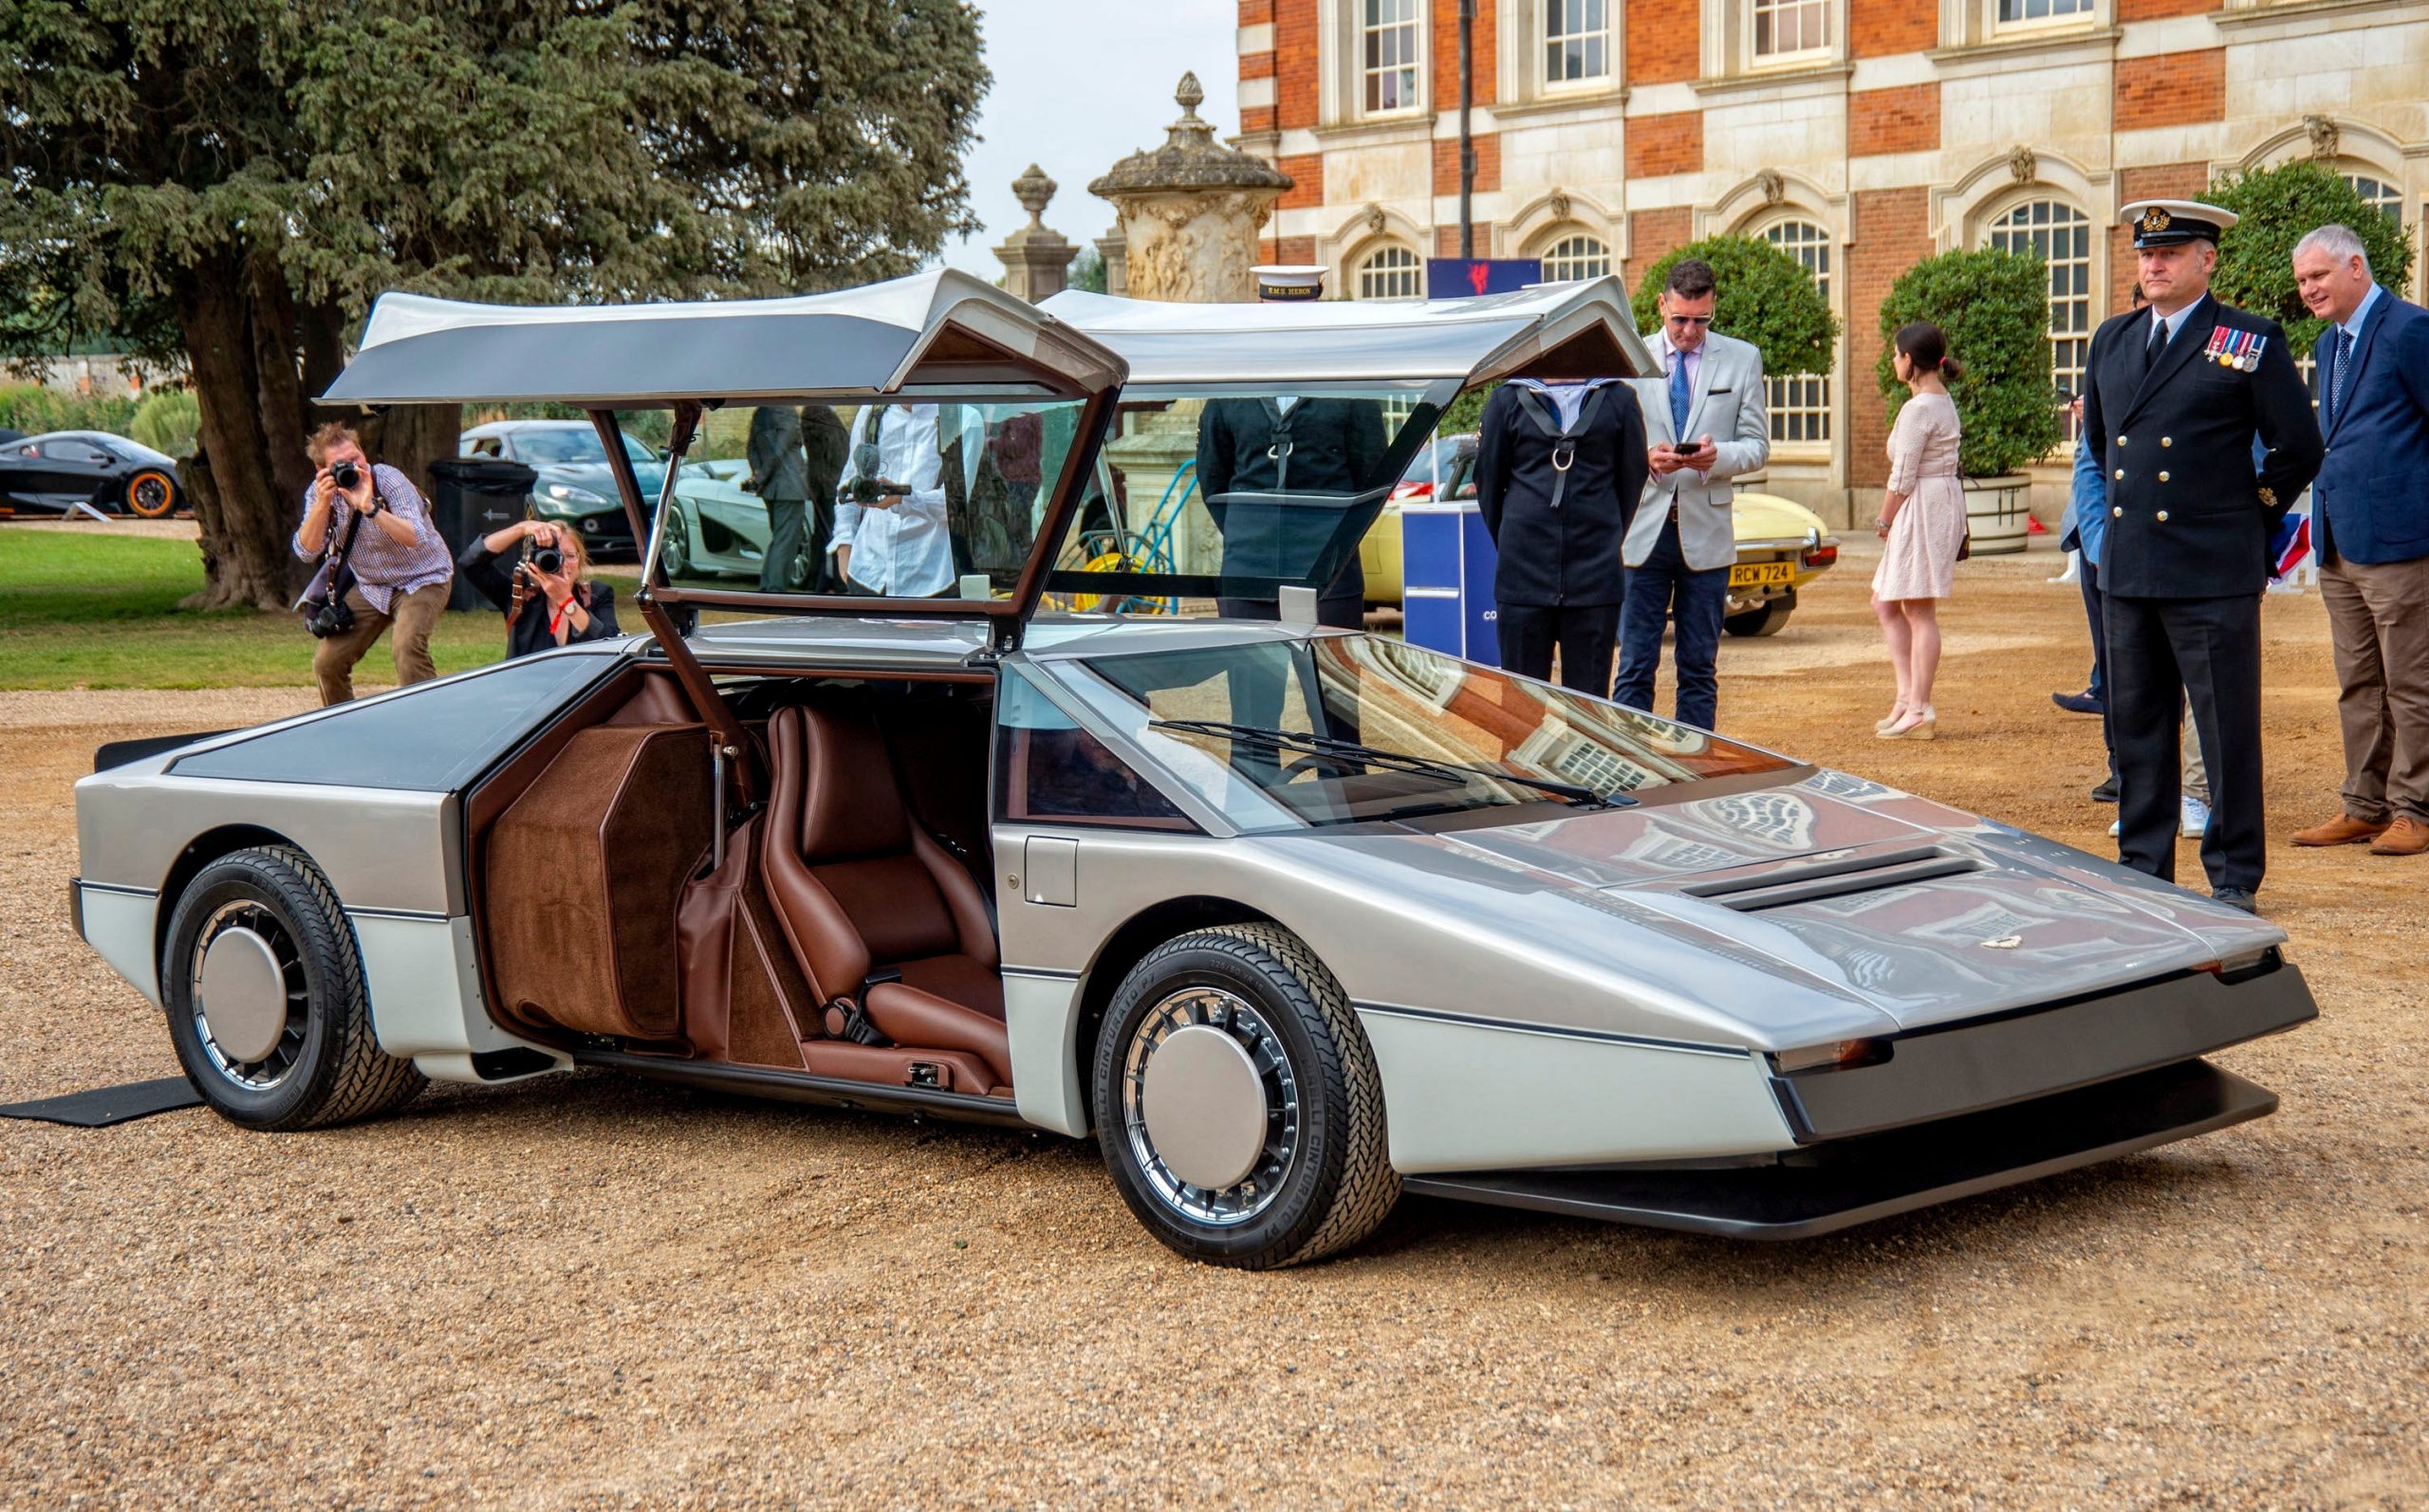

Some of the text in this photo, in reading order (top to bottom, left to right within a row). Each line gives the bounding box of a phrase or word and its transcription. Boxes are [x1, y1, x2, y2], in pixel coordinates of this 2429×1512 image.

[1734, 565, 1789, 582] RCW 724
[1099, 987, 1139, 1079] CINTURATO
[1140, 970, 1157, 989] P7
[1281, 1134, 1322, 1224] CINTURATO
[1262, 1221, 1280, 1242] P7
